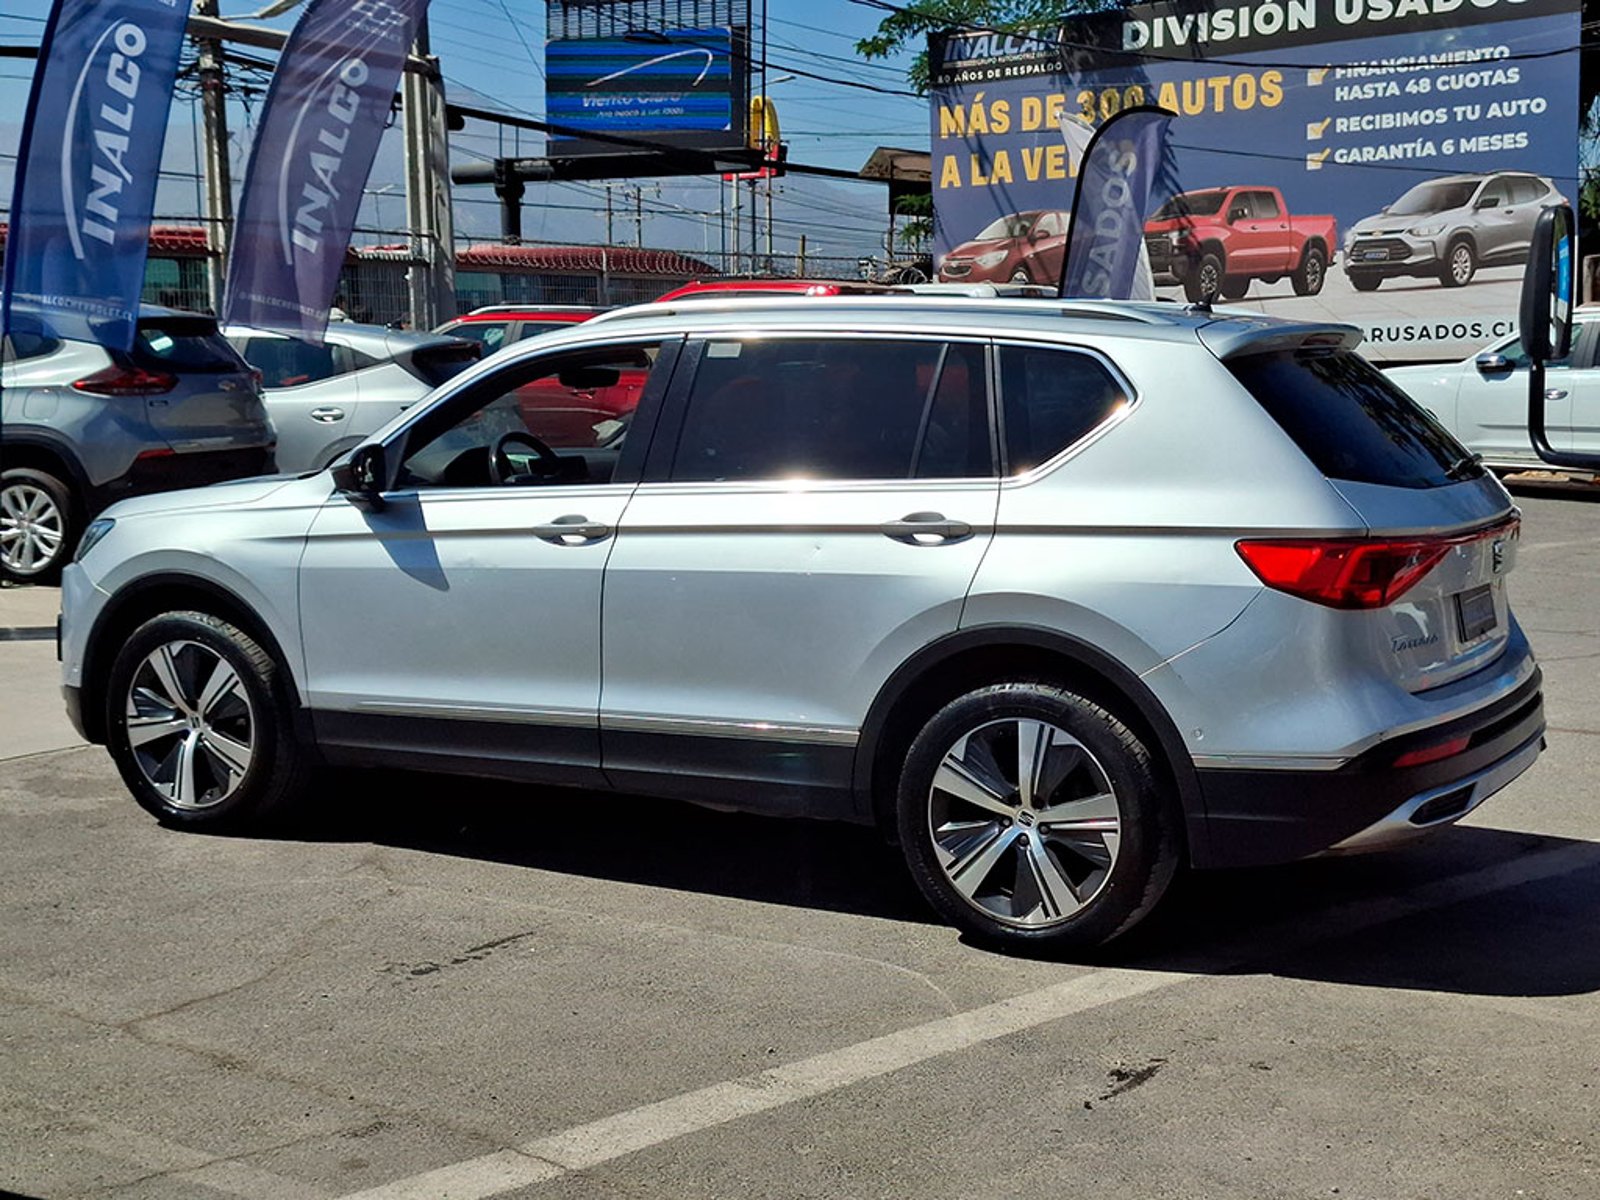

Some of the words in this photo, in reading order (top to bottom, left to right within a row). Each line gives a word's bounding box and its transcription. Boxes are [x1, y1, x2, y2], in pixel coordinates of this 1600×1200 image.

[1122, 0, 1317, 51] DIVISIÓN
[953, 69, 983, 83] AÑOS
[986, 69, 1001, 80] DE
[1004, 62, 1063, 77] RESPALDO
[1334, 45, 1511, 79] FINANCIAMIENTO
[1335, 81, 1401, 102] HASTA
[1405, 77, 1431, 95] 48
[1436, 67, 1521, 92] CUOTAS
[938, 91, 1011, 139] MÁS
[1022, 94, 1067, 132] DE
[1158, 70, 1284, 117] AUTOS
[1335, 108, 1448, 133] RECIBIMOS
[1453, 104, 1481, 122] TU
[1486, 97, 1548, 119] AUTO
[82, 23, 147, 245] INALCO
[1334, 138, 1437, 164] GARANTÍA
[1441, 139, 1455, 156] 6
[1460, 132, 1529, 154] MESES
[292, 58, 369, 253] INALCO
[939, 154, 961, 189] A
[970, 149, 1013, 187] LA
